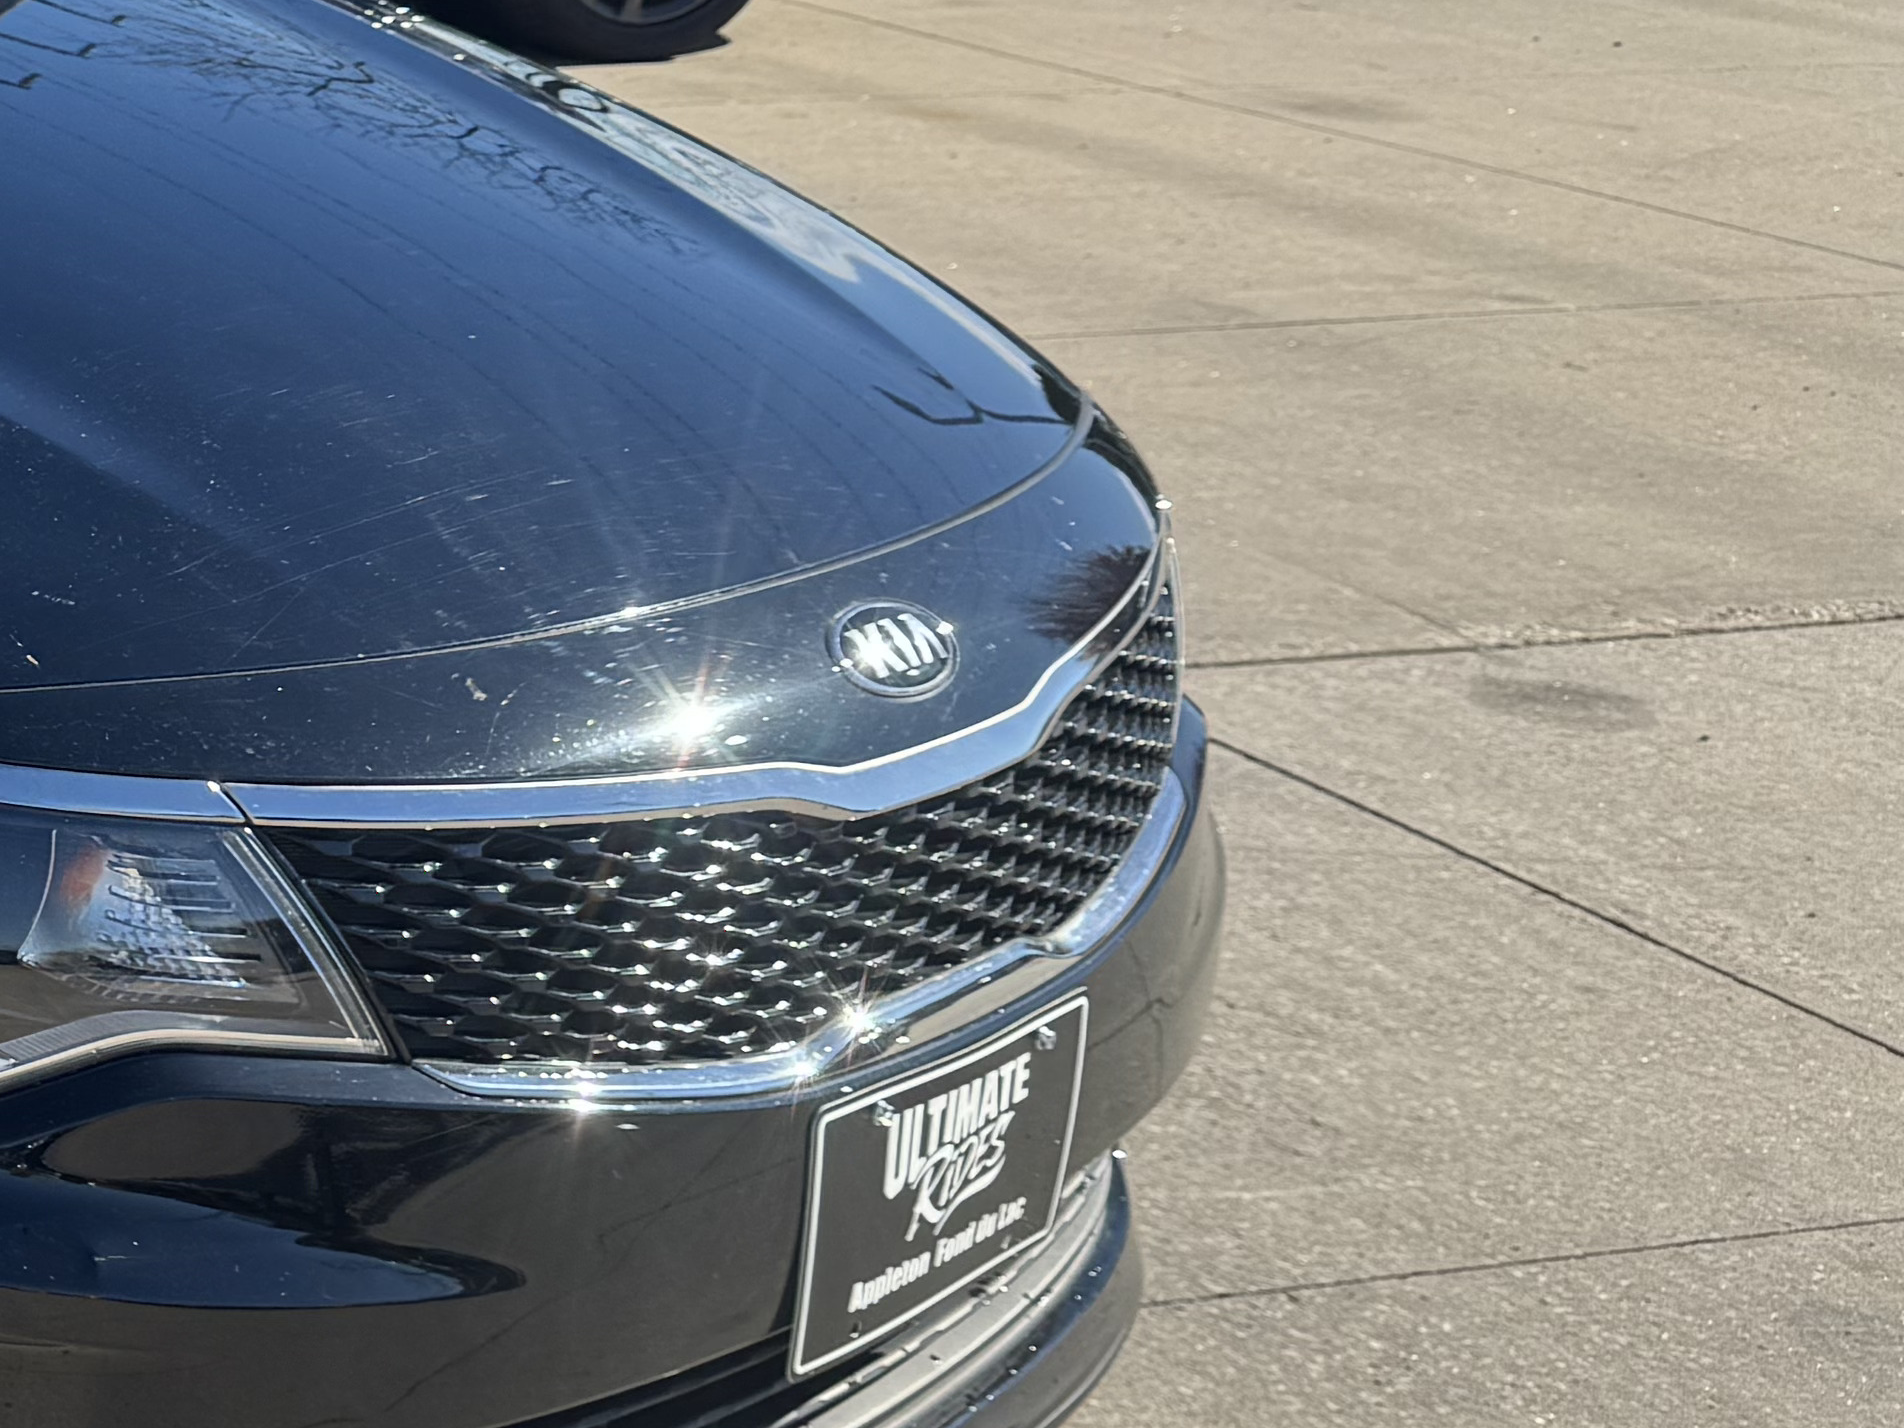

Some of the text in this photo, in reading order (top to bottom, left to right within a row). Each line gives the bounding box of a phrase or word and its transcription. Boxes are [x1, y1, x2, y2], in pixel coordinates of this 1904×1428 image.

[843, 612, 949, 679] KIA
[882, 1051, 1033, 1200] ULTIMATE
[846, 1251, 933, 1314] Appleton
[933, 1219, 977, 1268] Fond
